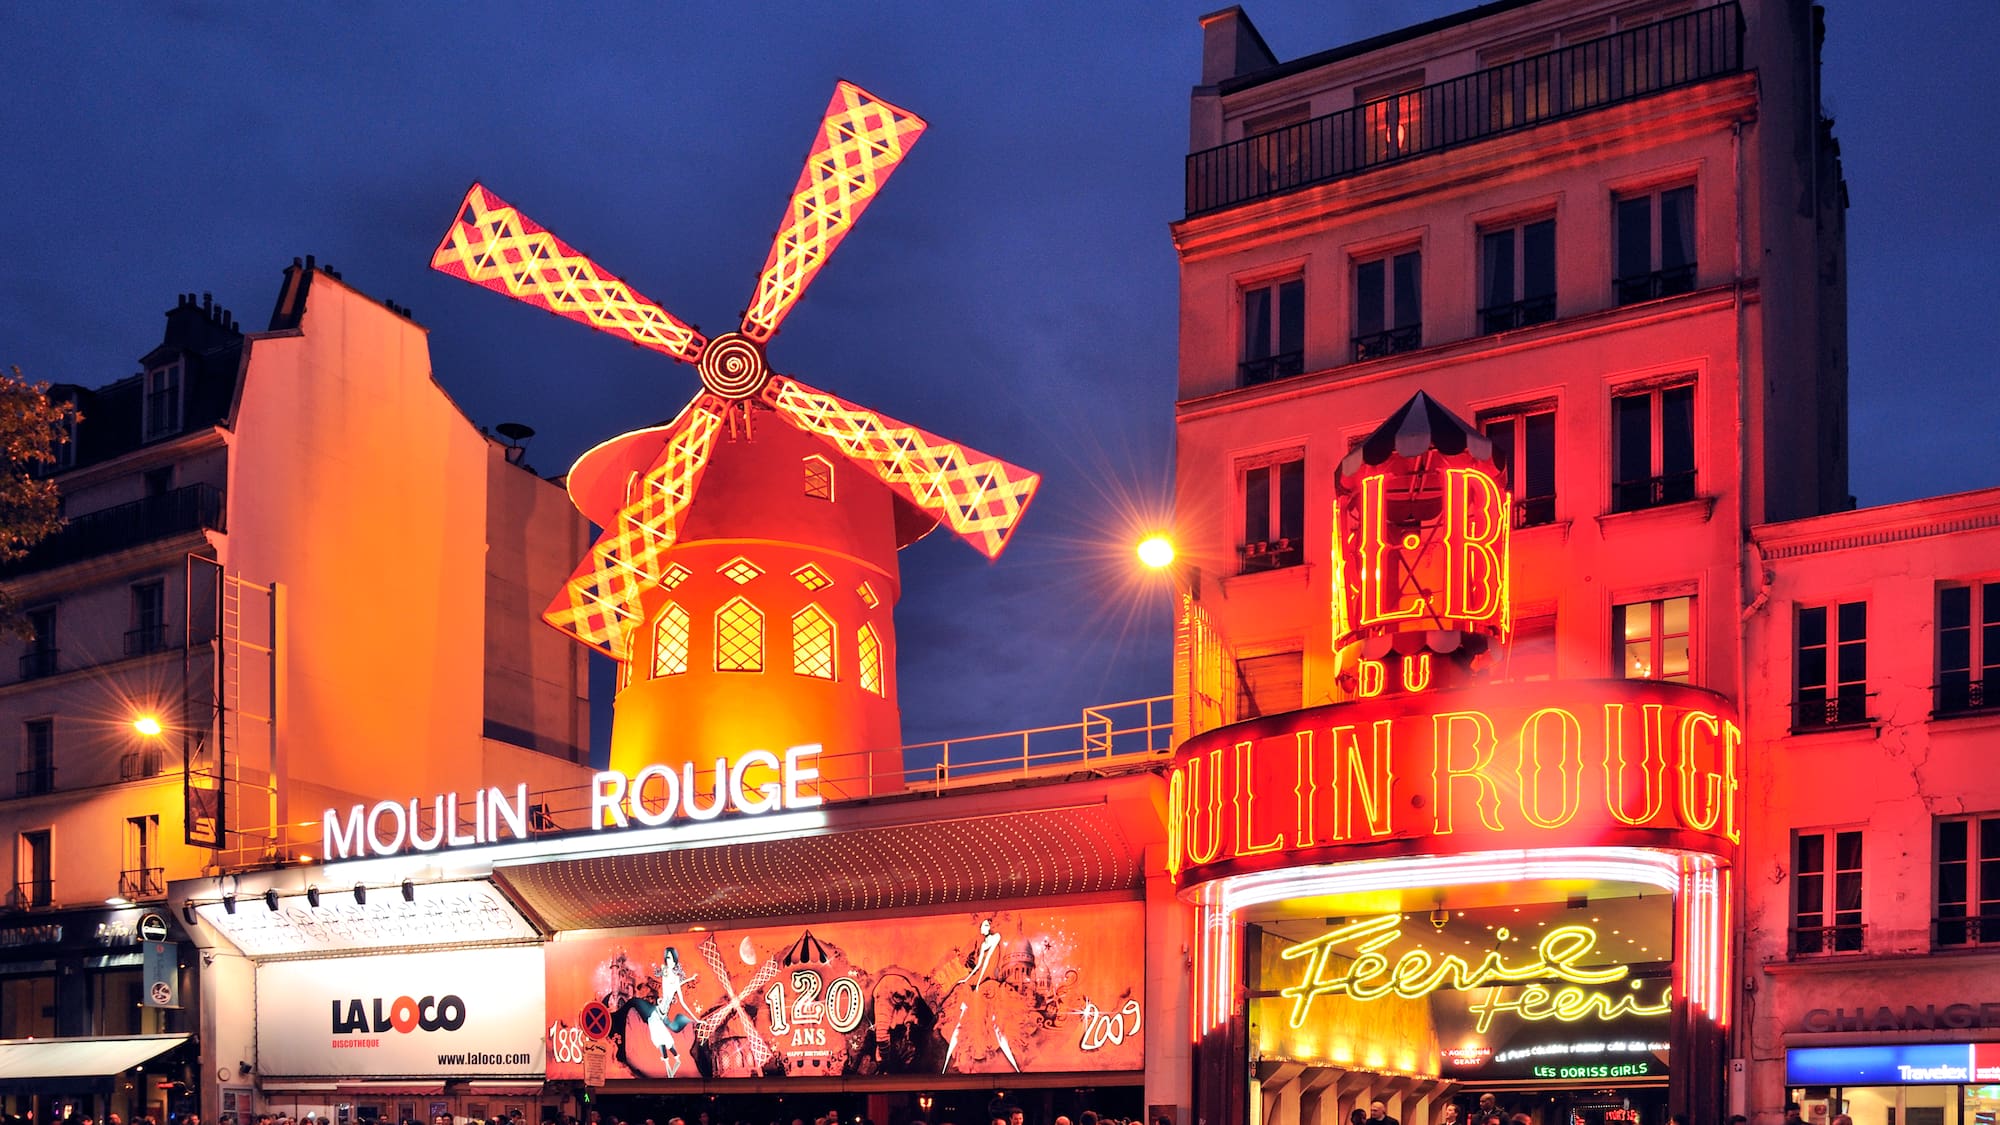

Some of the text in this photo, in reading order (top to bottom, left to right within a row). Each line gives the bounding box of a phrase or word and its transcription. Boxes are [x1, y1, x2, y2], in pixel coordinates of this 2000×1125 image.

[1359, 655, 1430, 698] DU
[322, 744, 824, 860] MOULIN ROUGE
[1168, 704, 1741, 884] OULIN ROUGE
[1281, 913, 1629, 1029] Féerie
[765, 970, 864, 1036] 120
[1803, 1002, 2000, 1033] CHANGE
[332, 1039, 380, 1048] DISCOTHEQUE
[791, 1028, 826, 1047] ANS
[1080, 1000, 1142, 1051] 2009
[437, 1052, 531, 1065] www.laloco.com
[1534, 1062, 1648, 1078] LES DORISS GIRLS
[1898, 1064, 1967, 1080] Travelex
